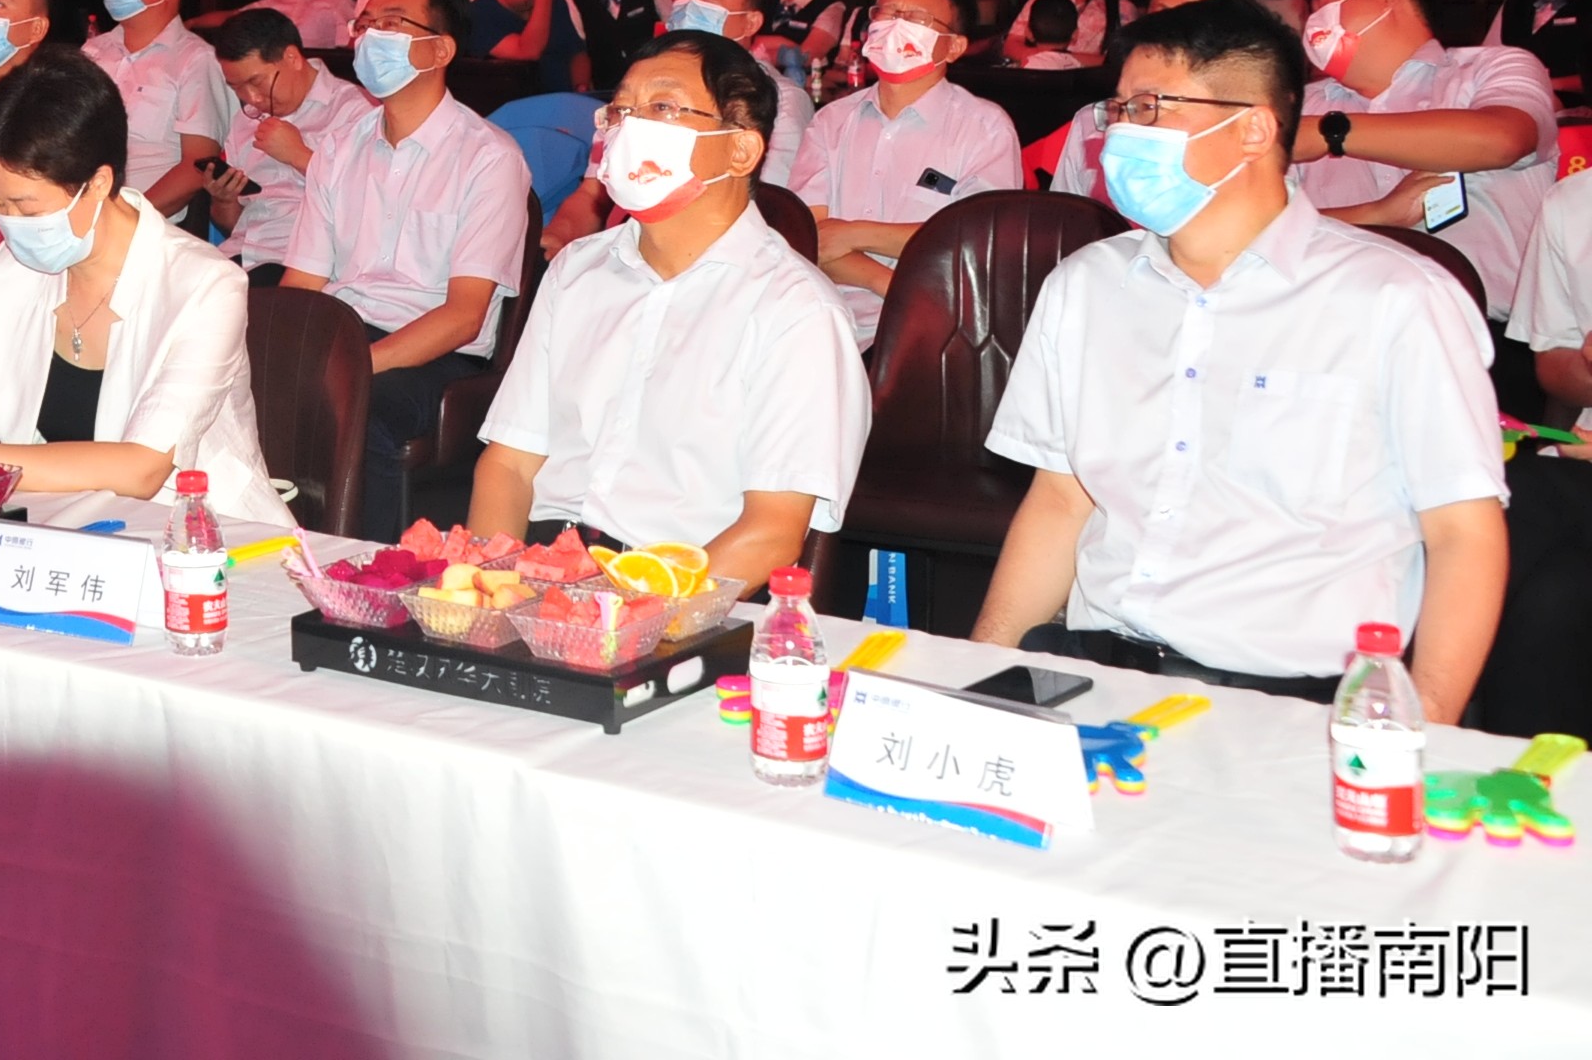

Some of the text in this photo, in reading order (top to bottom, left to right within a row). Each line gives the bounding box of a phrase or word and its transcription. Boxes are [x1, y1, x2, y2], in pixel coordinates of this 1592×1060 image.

[11, 565, 106, 603] 刘军伟
[888, 566, 897, 605] BANK
[875, 731, 1016, 797] 刘小虎
